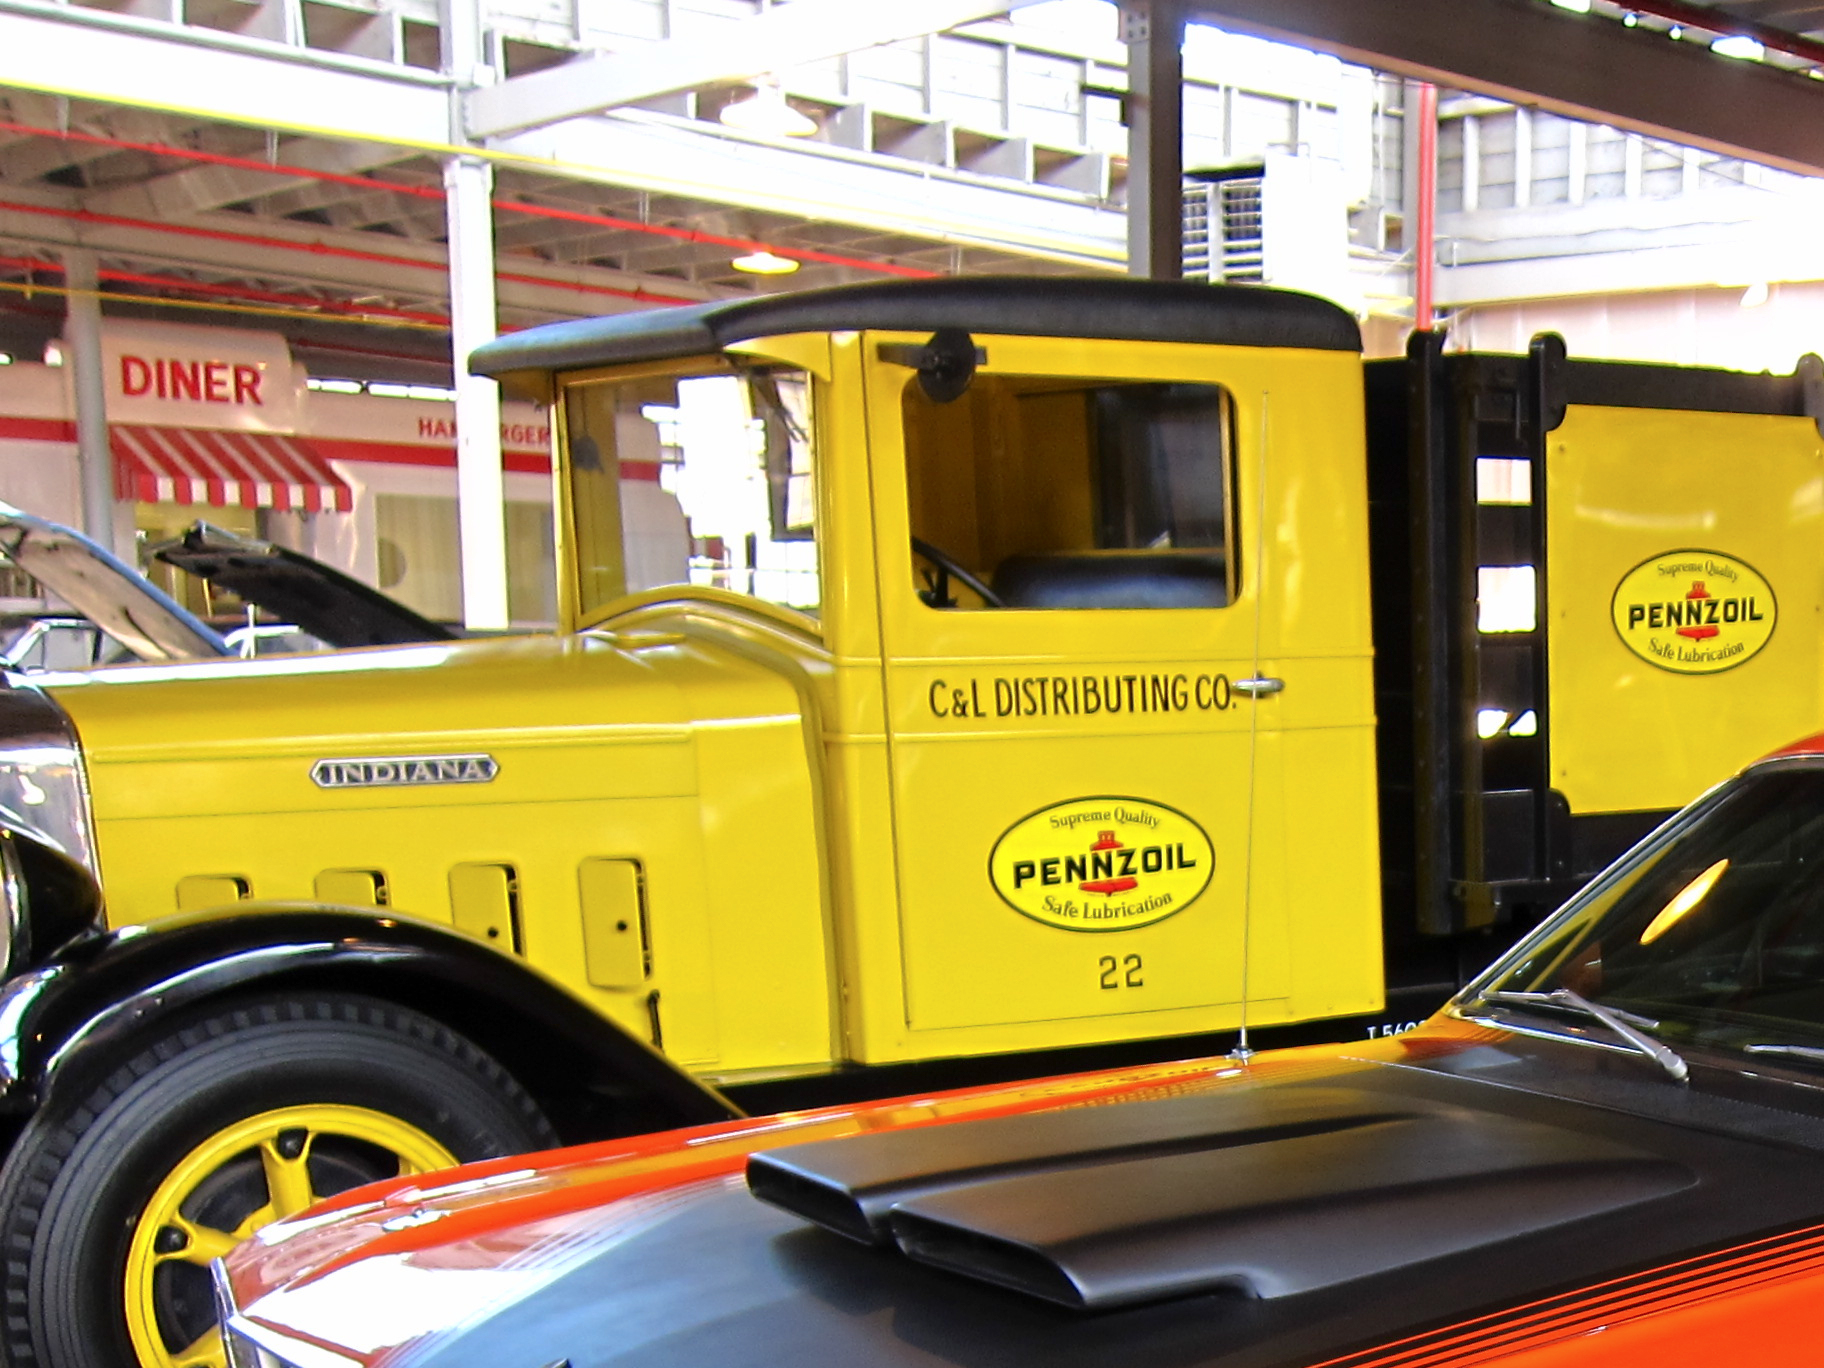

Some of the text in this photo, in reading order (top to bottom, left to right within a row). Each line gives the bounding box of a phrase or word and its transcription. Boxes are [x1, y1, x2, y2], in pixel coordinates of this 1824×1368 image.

[121, 354, 263, 406] DINER
[1657, 559, 1739, 583] Supreme Quality
[1627, 596, 1764, 630] PENNZOIL
[1648, 637, 1745, 663] Safe Lubrication
[928, 672, 1238, 719] C&L DISTRIBUTING CO.
[328, 758, 489, 784] INDIANA
[1049, 806, 1161, 831] Supreme Quality
[1013, 842, 1197, 889] PENNZOIL
[1041, 892, 1174, 919] Safe Lubrication
[1099, 953, 1144, 990] 22
